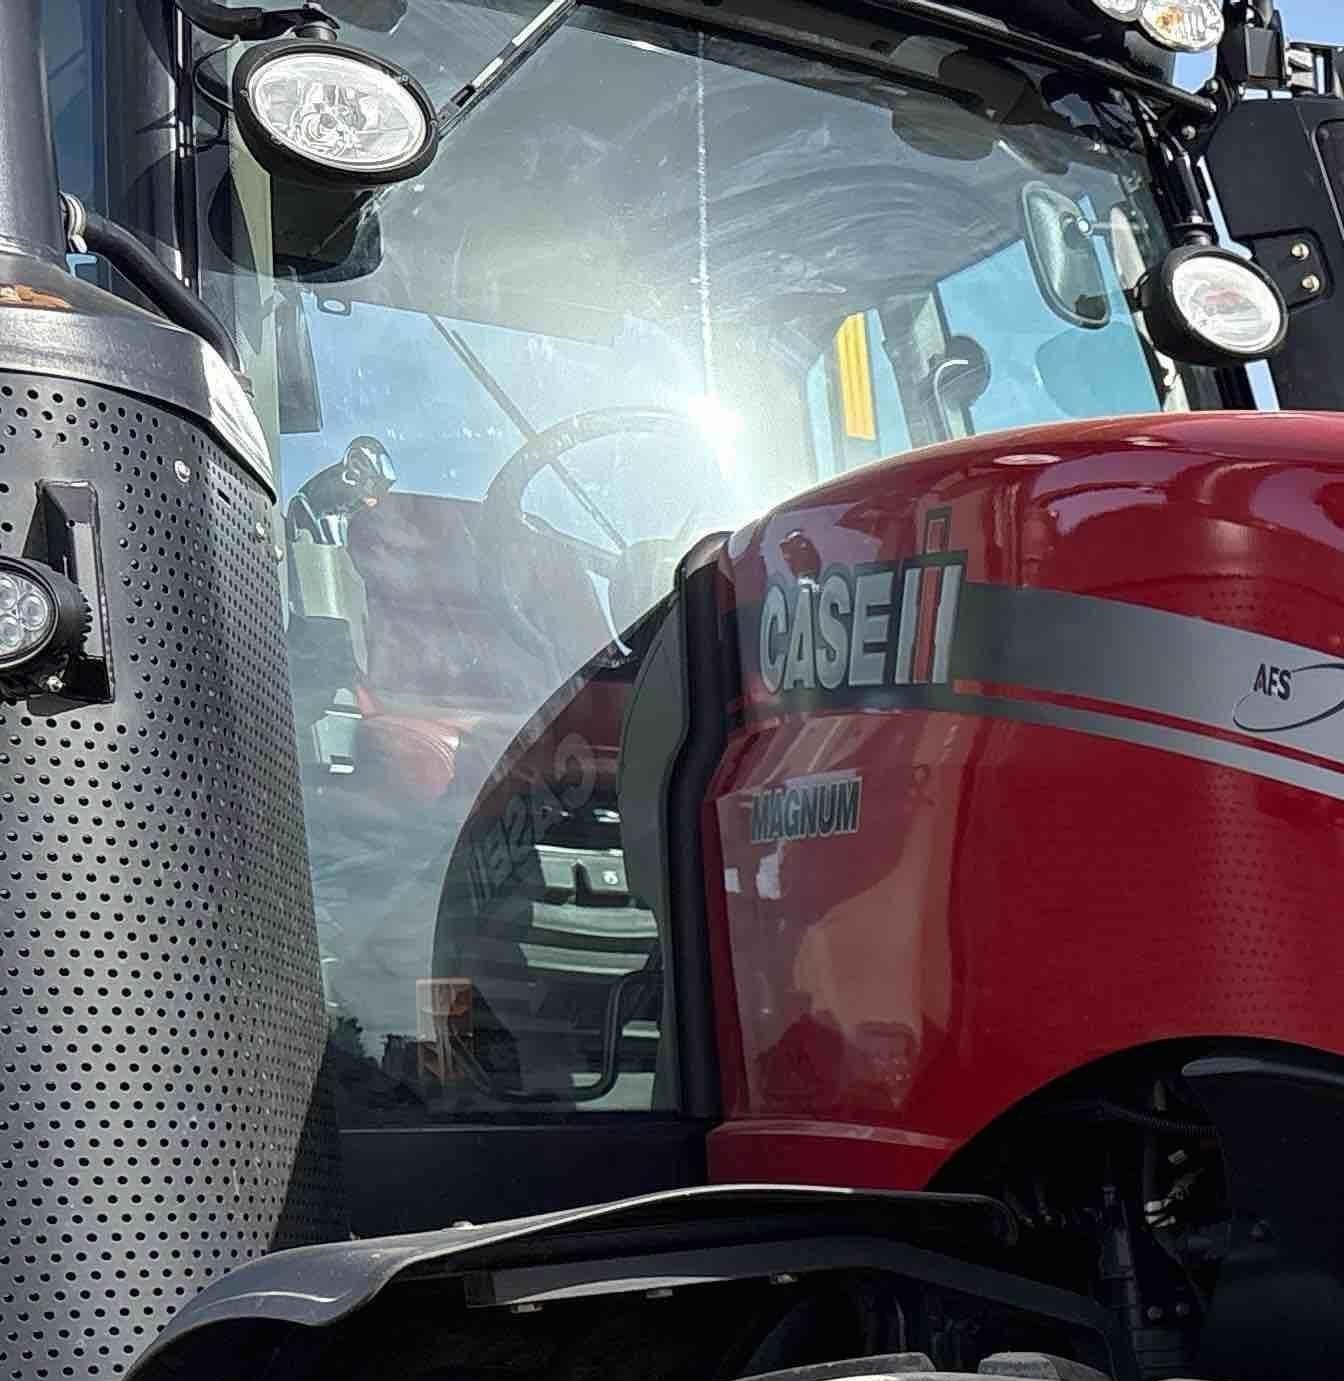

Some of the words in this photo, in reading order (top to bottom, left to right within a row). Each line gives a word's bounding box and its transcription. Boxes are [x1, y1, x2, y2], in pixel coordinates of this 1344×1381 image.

[758, 562, 896, 694] CASE
[1253, 663, 1292, 701] AFS
[751, 780, 861, 843] MAGNUM
